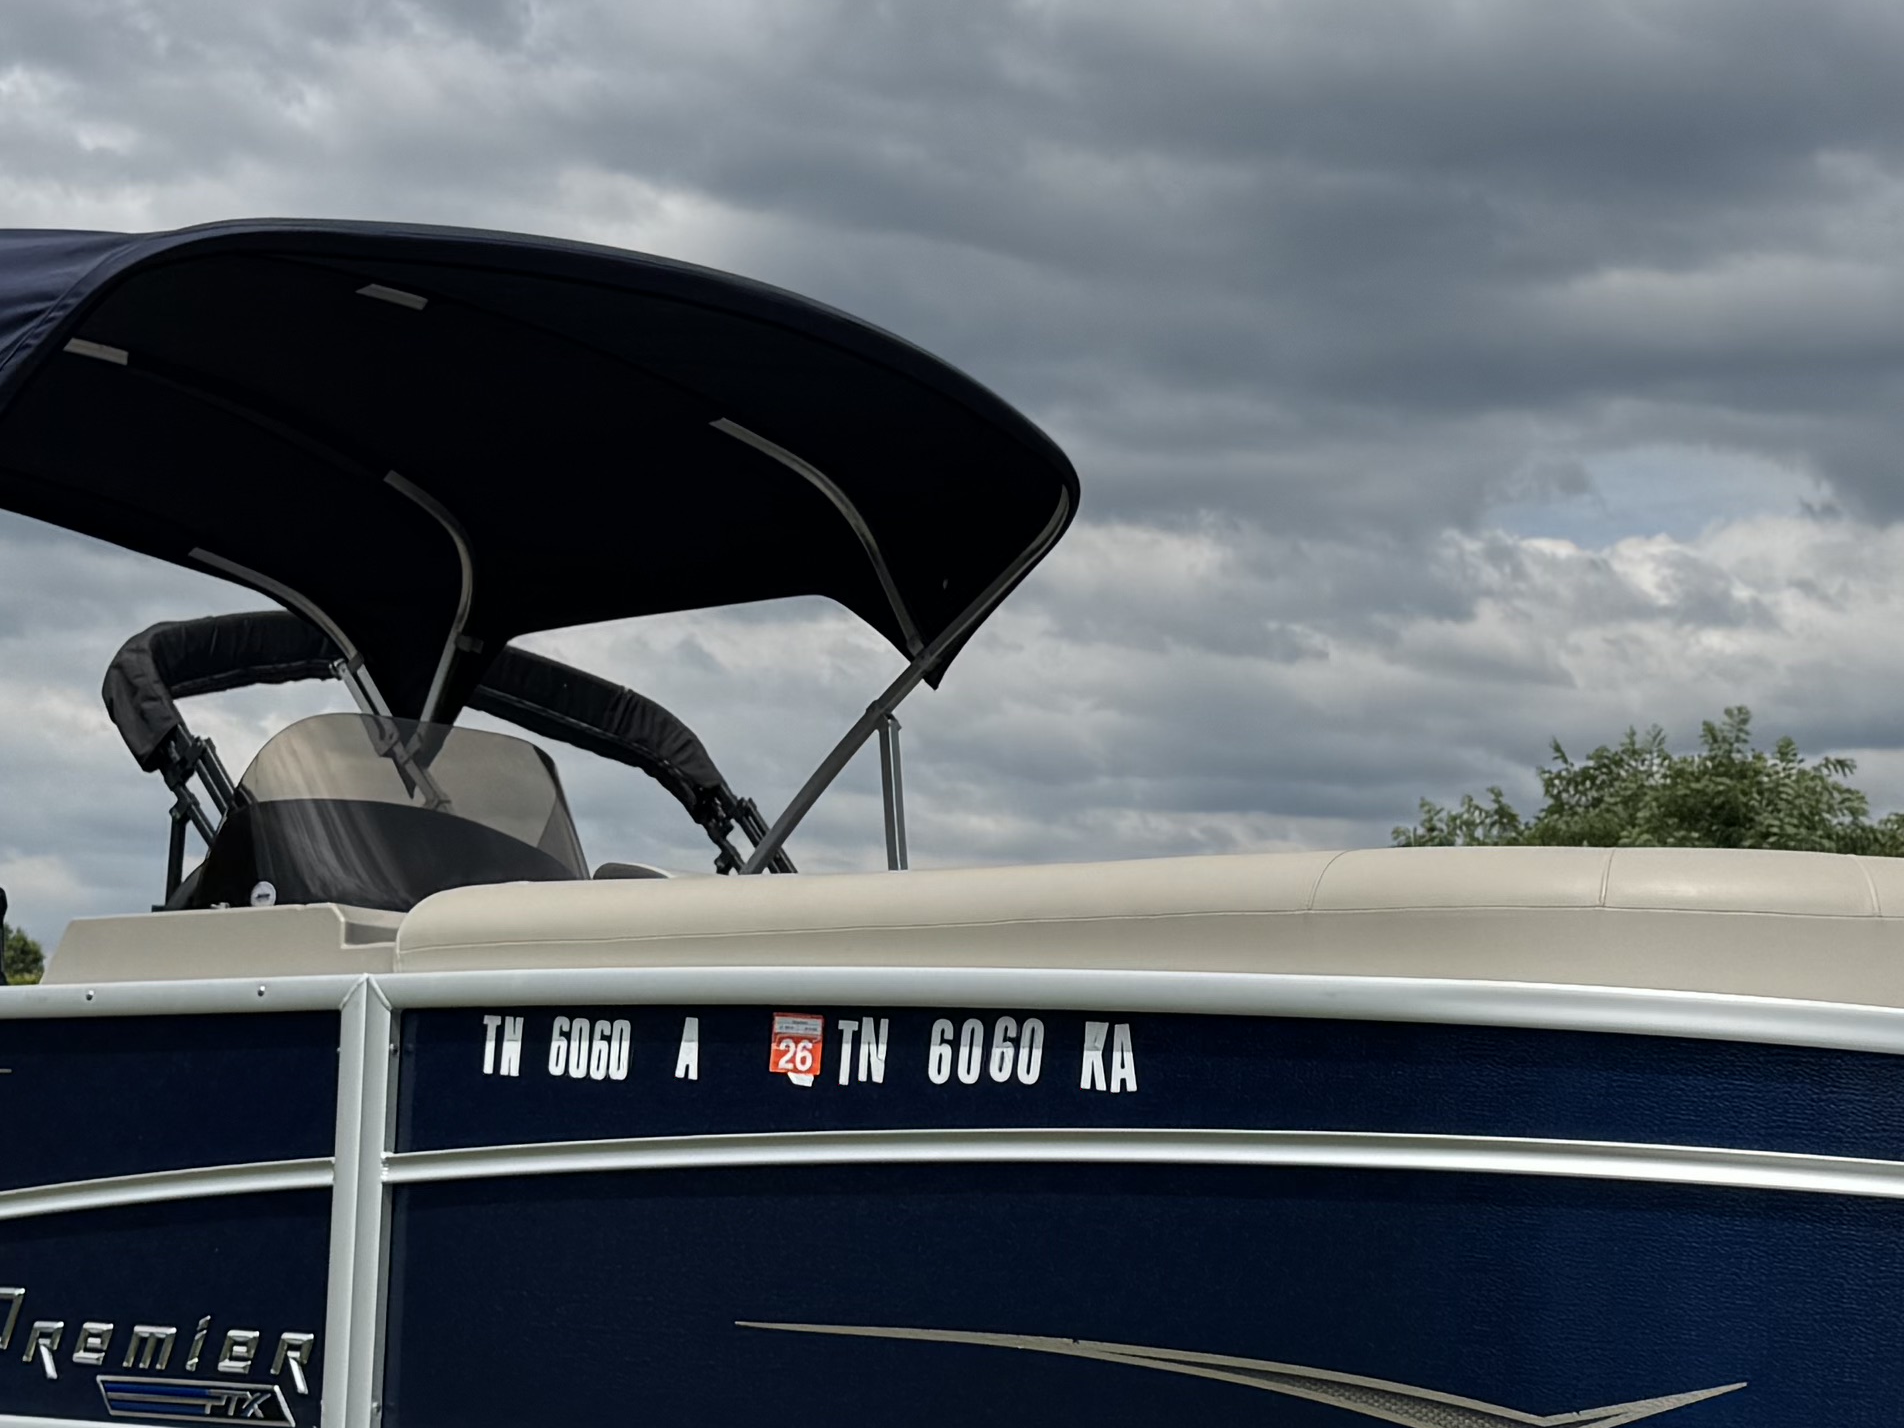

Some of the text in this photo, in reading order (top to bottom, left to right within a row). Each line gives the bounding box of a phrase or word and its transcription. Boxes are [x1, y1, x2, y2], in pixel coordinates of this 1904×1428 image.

[483, 1014, 699, 1081] TN 6060 A
[777, 1038, 813, 1072] 26
[838, 1016, 1138, 1093] TN 6060 KA
[204, 1388, 272, 1418] PTX
